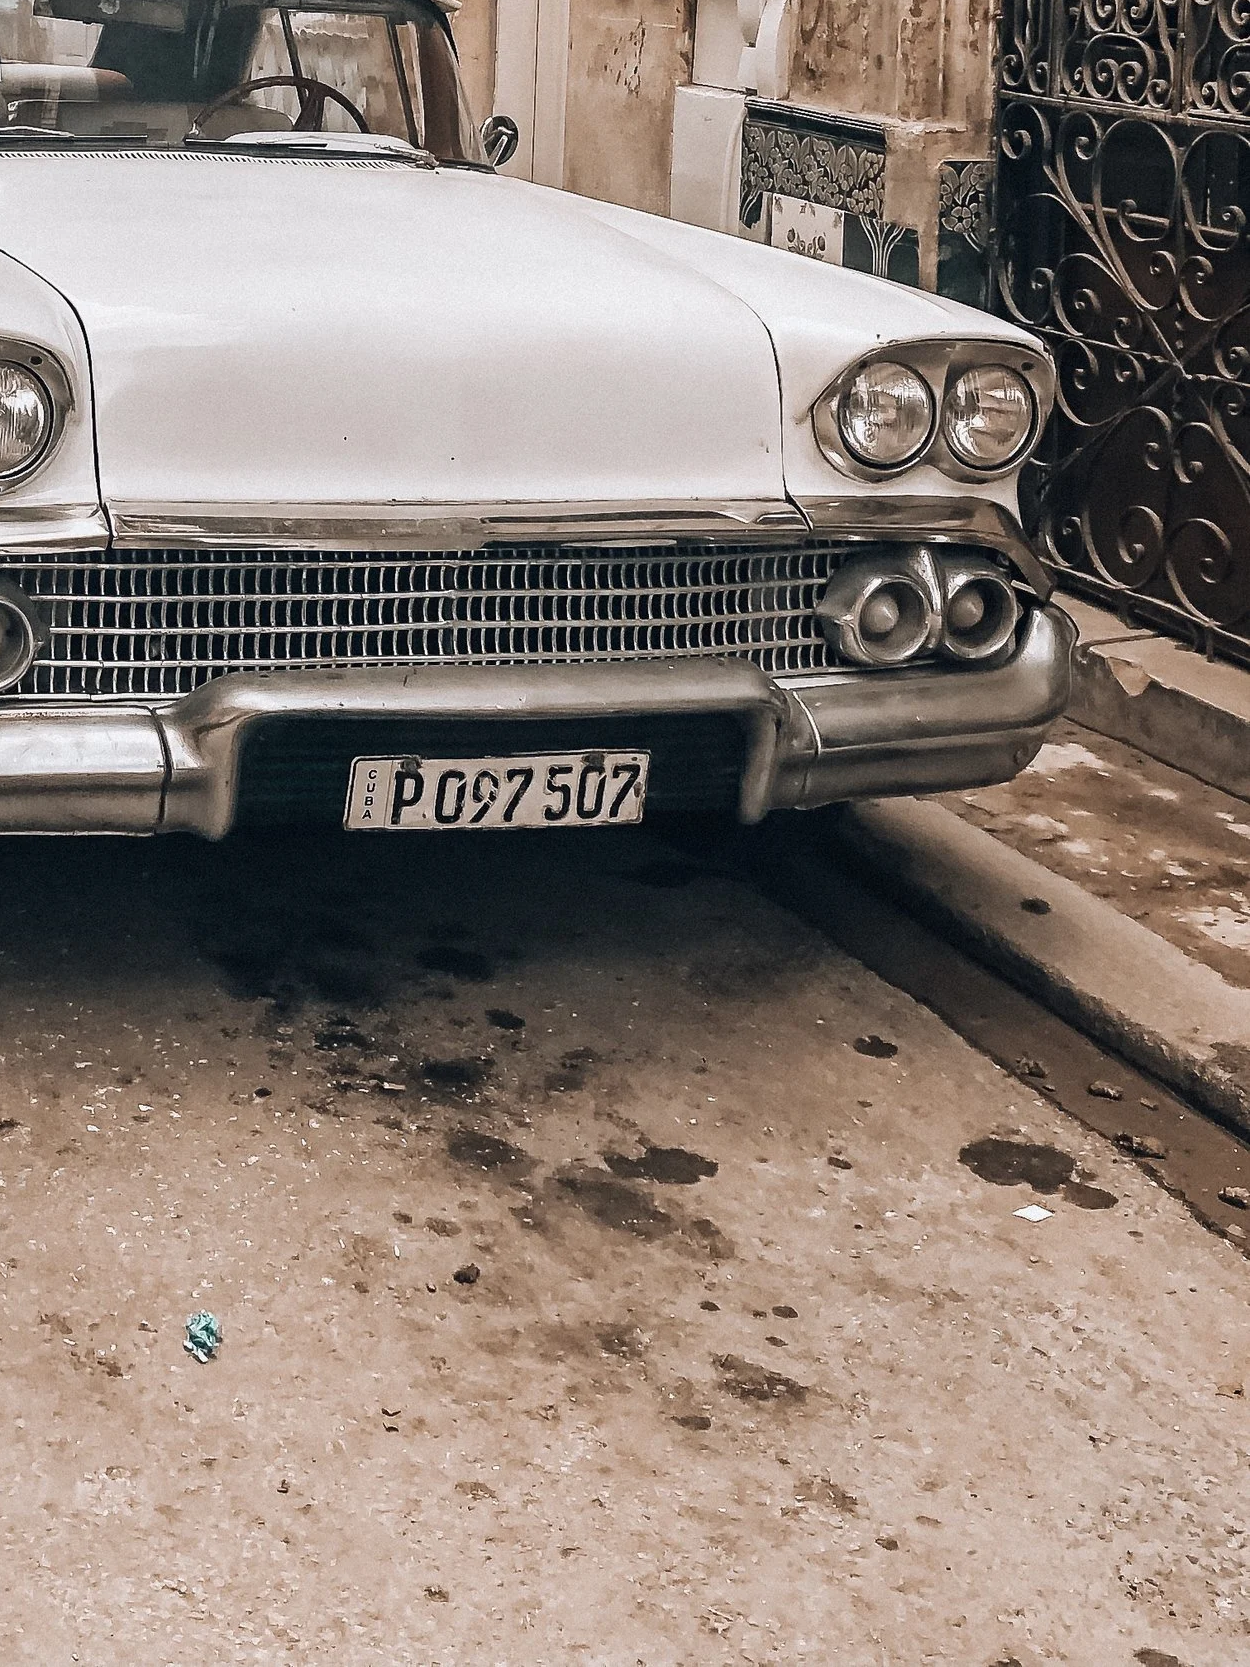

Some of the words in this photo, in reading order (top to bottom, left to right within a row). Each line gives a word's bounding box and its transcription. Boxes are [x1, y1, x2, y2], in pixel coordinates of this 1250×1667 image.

[361, 769, 378, 820] CUBA
[390, 769, 425, 825] P
[433, 767, 535, 825] 097
[544, 763, 642, 822] 507
